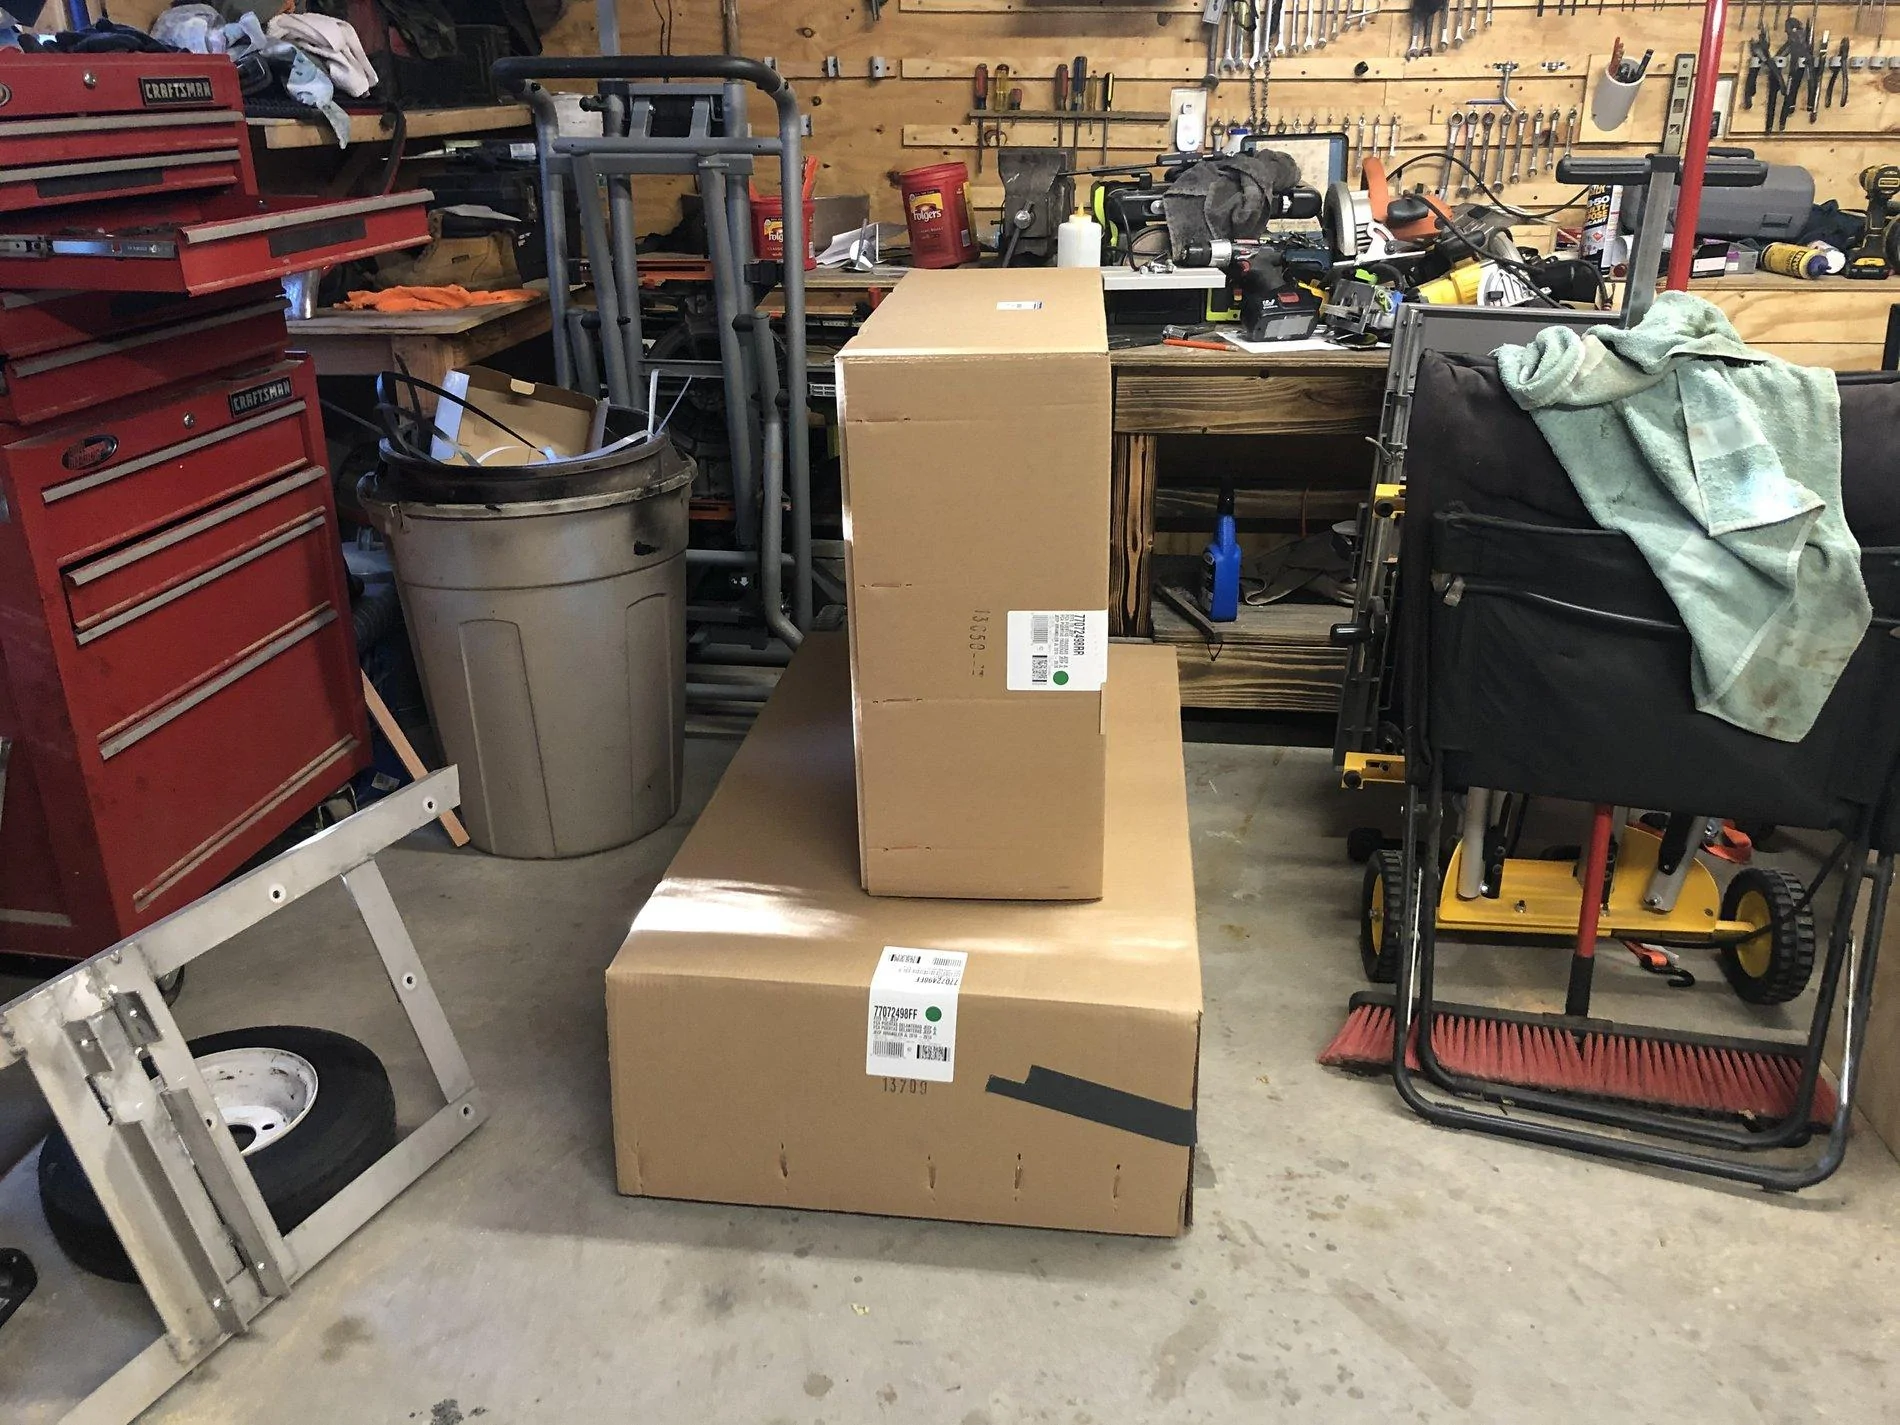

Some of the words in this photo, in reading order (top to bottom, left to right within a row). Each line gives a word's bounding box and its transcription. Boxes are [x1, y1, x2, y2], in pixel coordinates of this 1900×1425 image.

[145, 82, 212, 99] CRAFTSMAN
[913, 209, 942, 222] Folgers
[768, 230, 784, 243] Folg
[233, 380, 291, 411] CRAFTSMAN
[1073, 614, 1086, 656] 77072498RR
[874, 1006, 918, 1020] 77072498FF
